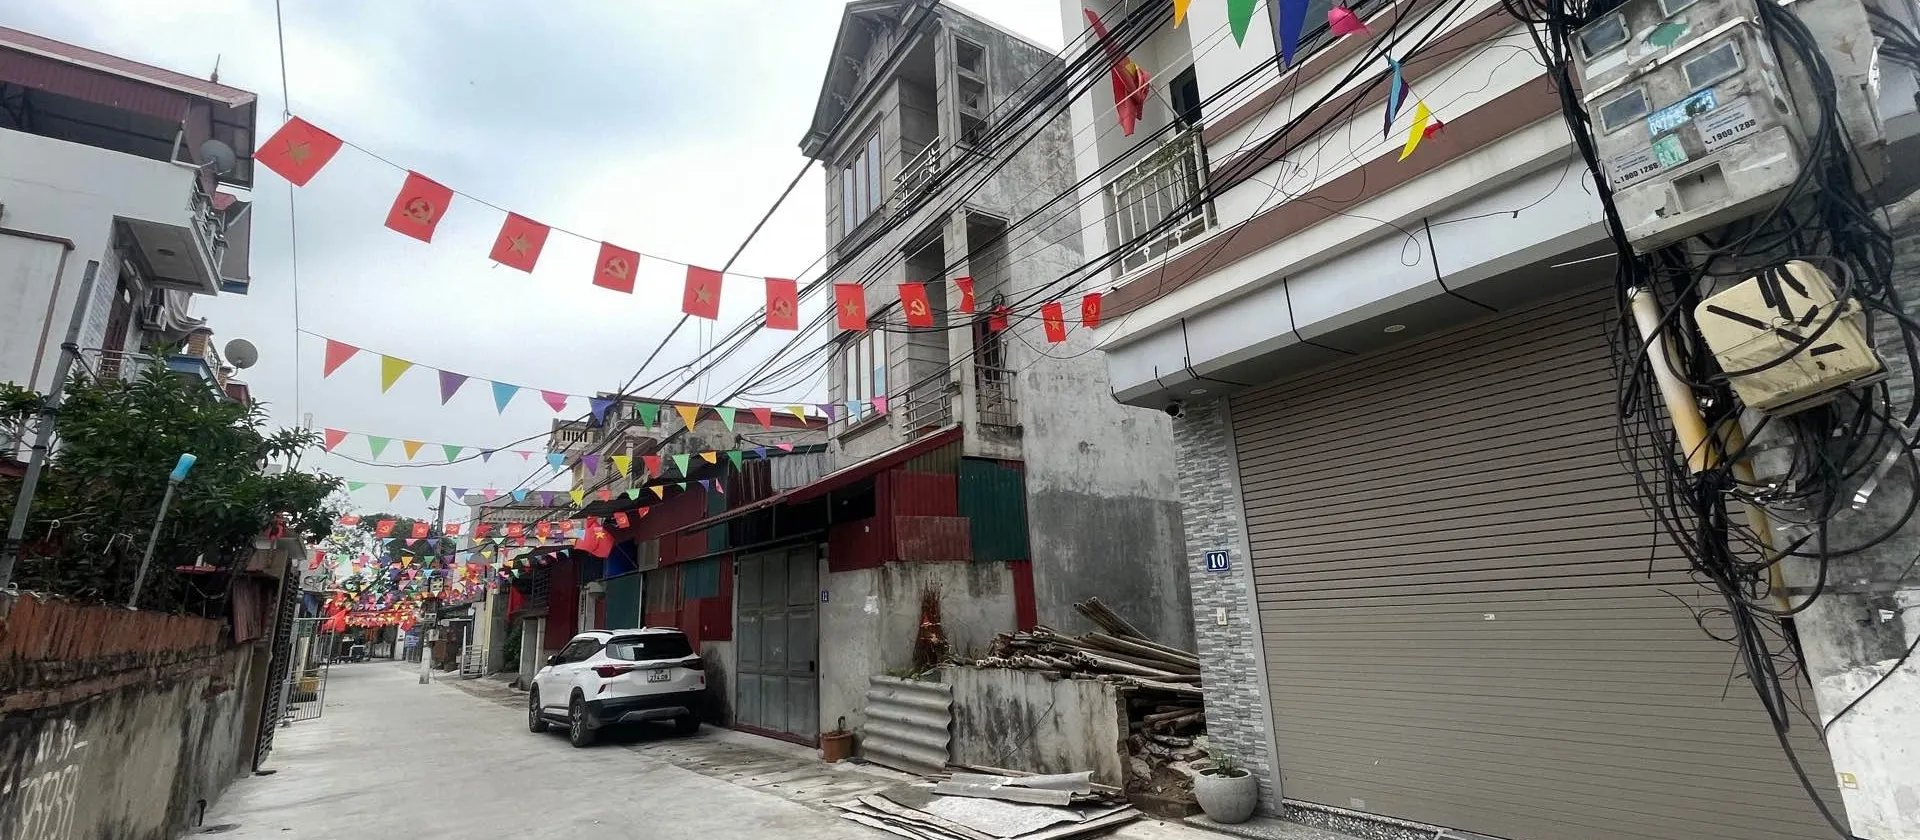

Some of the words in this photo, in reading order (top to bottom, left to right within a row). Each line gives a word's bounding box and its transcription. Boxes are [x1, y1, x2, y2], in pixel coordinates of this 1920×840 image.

[1712, 128, 1733, 142] 1900
[1734, 119, 1757, 132] 1288
[1620, 170, 1639, 182] 1900
[1211, 554, 1225, 568] 10
